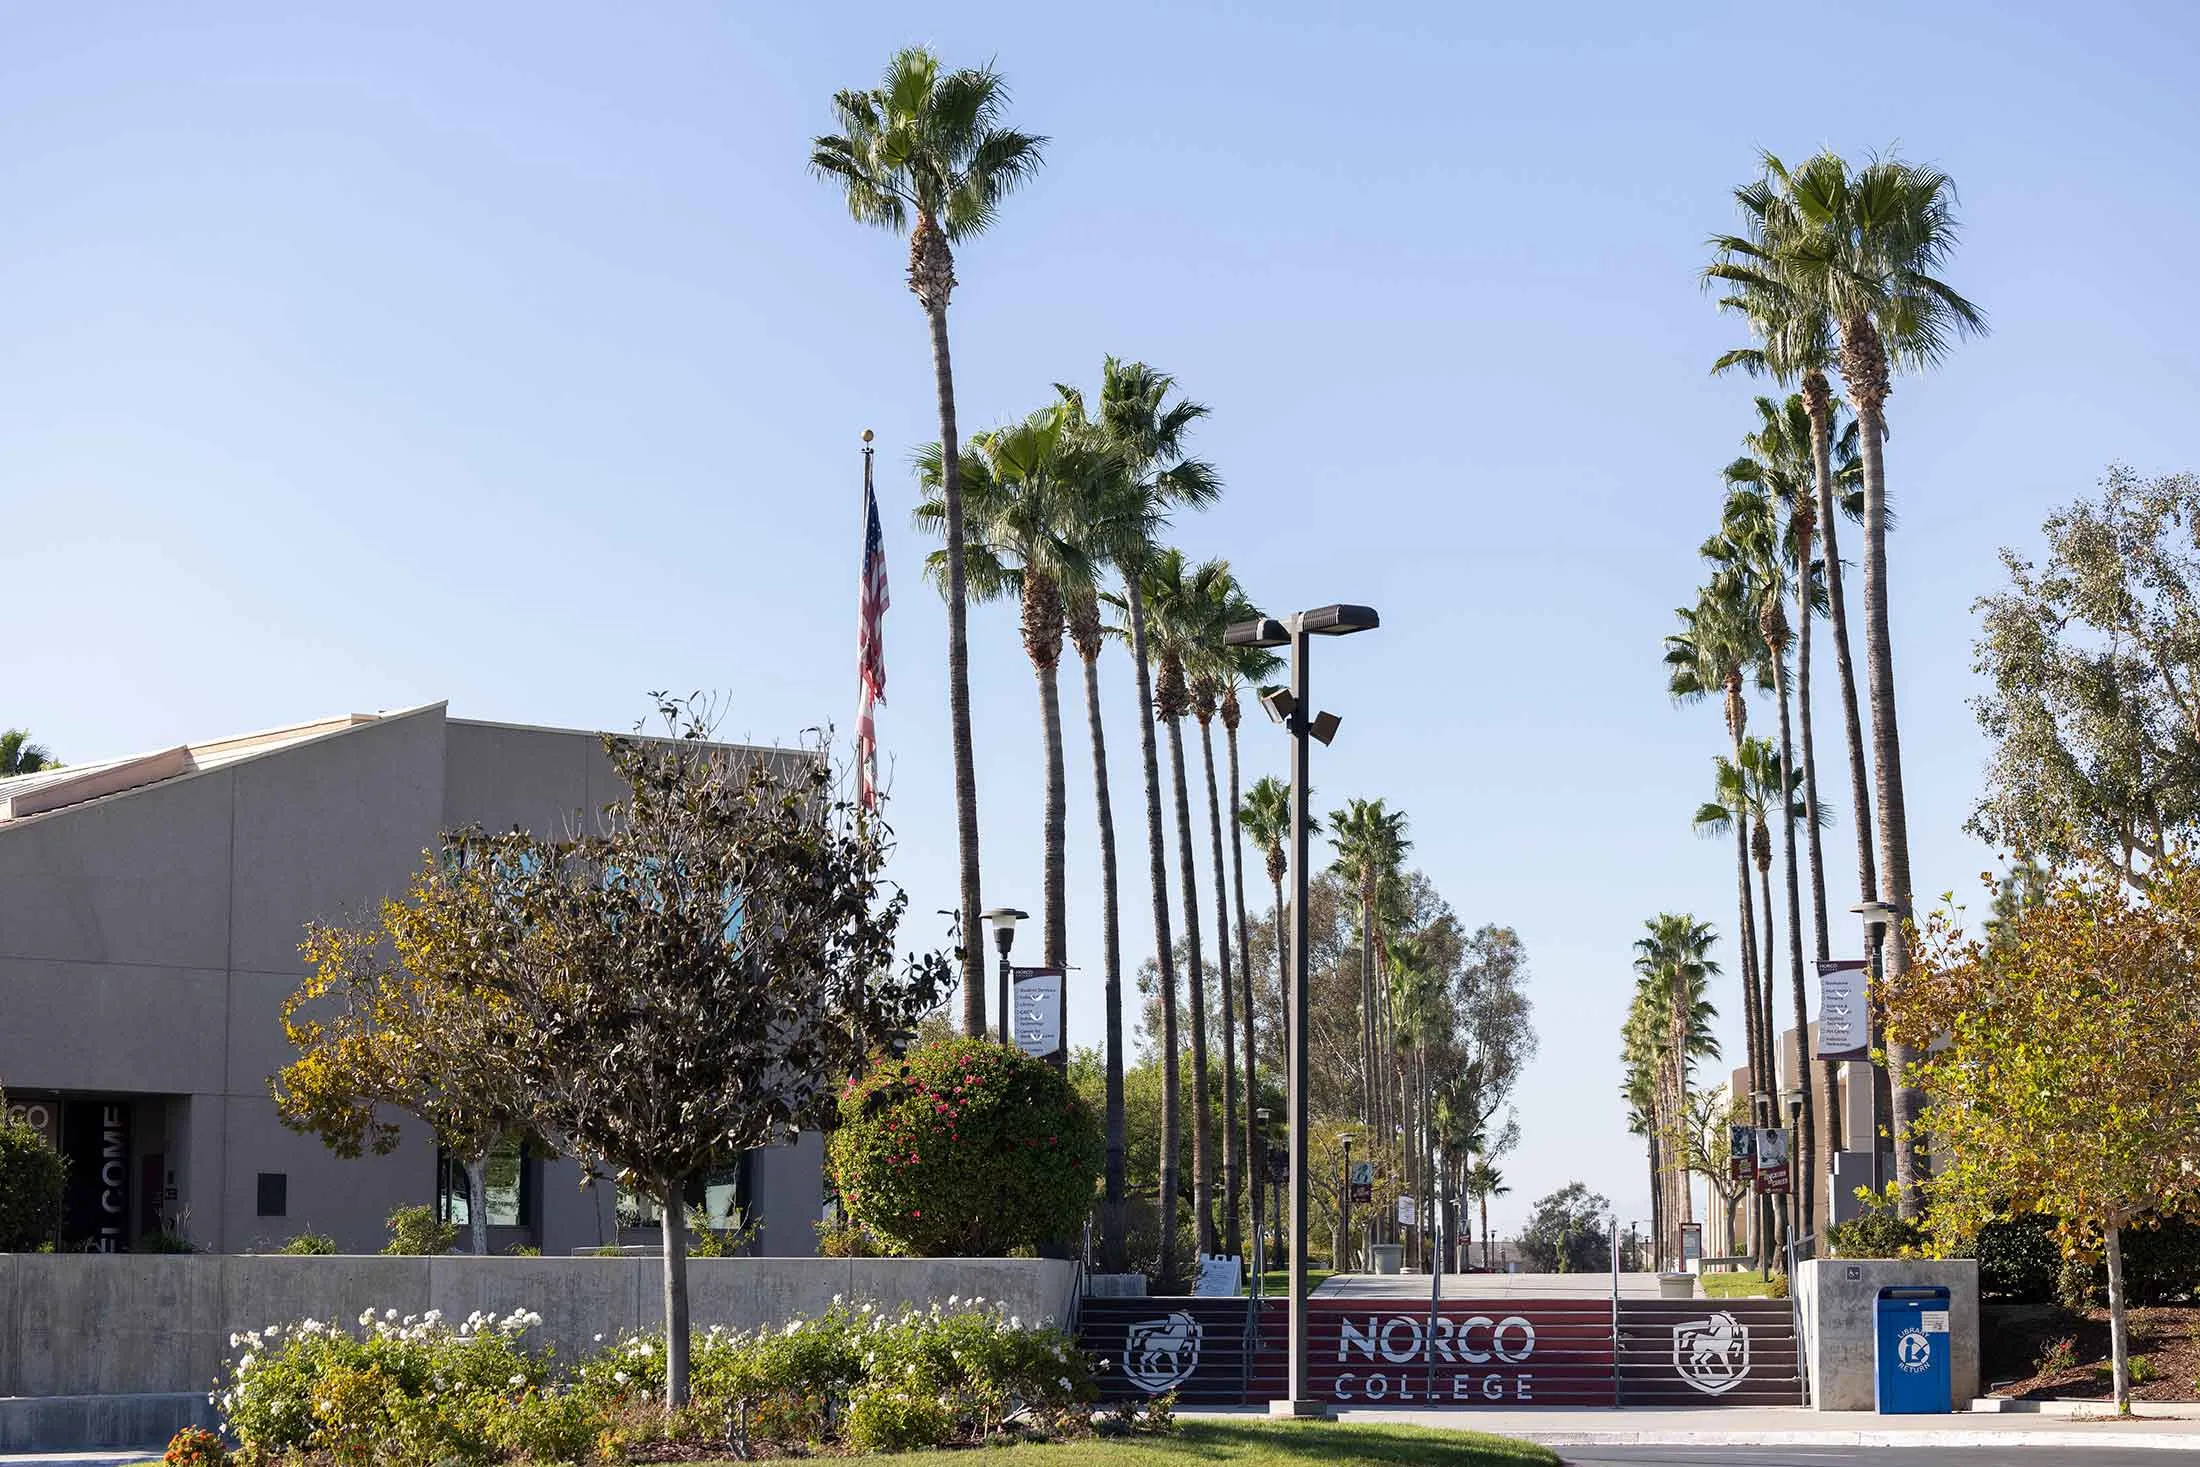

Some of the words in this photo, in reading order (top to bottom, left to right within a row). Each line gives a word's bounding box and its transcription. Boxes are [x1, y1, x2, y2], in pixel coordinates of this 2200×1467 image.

[101, 1105, 123, 1253] ELCOME
[1338, 1316, 1535, 1363] NORCO
[1897, 1327, 1930, 1339] LIBRARY
[1897, 1361, 1931, 1373] RETURN
[1335, 1373, 1532, 1400] COLLEGE
